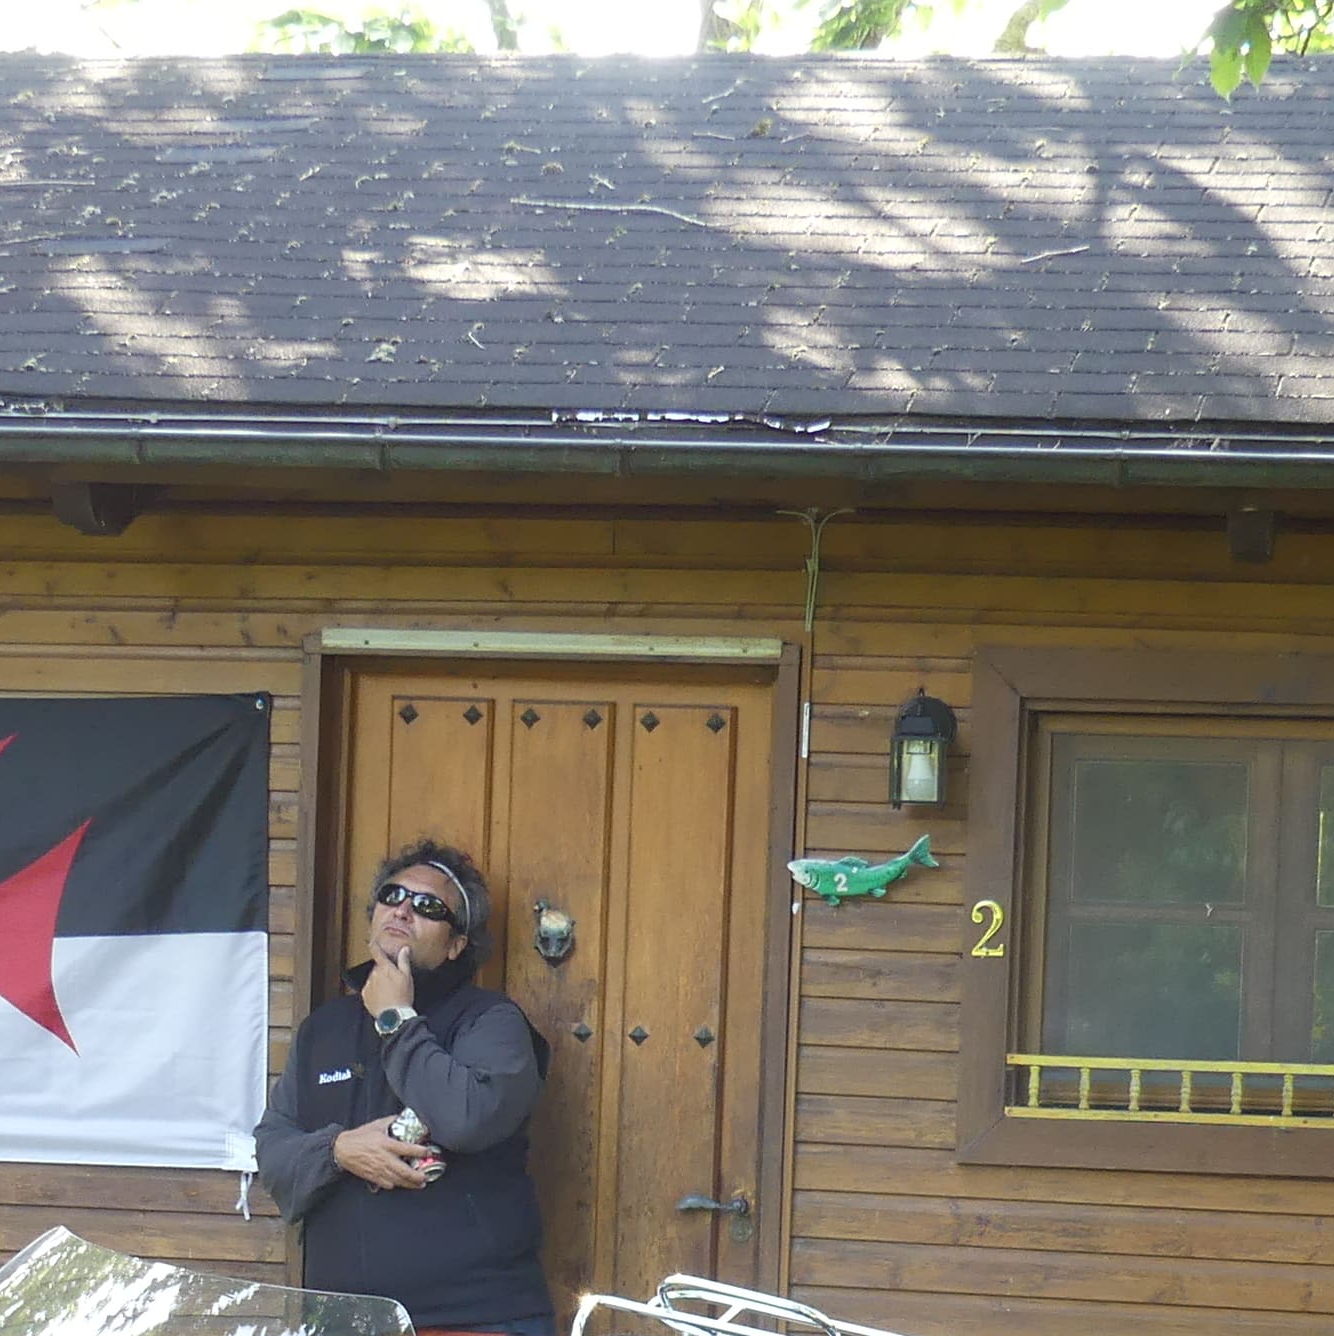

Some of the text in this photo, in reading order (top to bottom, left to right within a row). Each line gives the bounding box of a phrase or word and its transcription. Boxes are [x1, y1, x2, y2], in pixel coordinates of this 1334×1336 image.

[834, 872, 848, 892] 2
[971, 900, 1004, 957] 2
[318, 1068, 352, 1085] Kodiak
